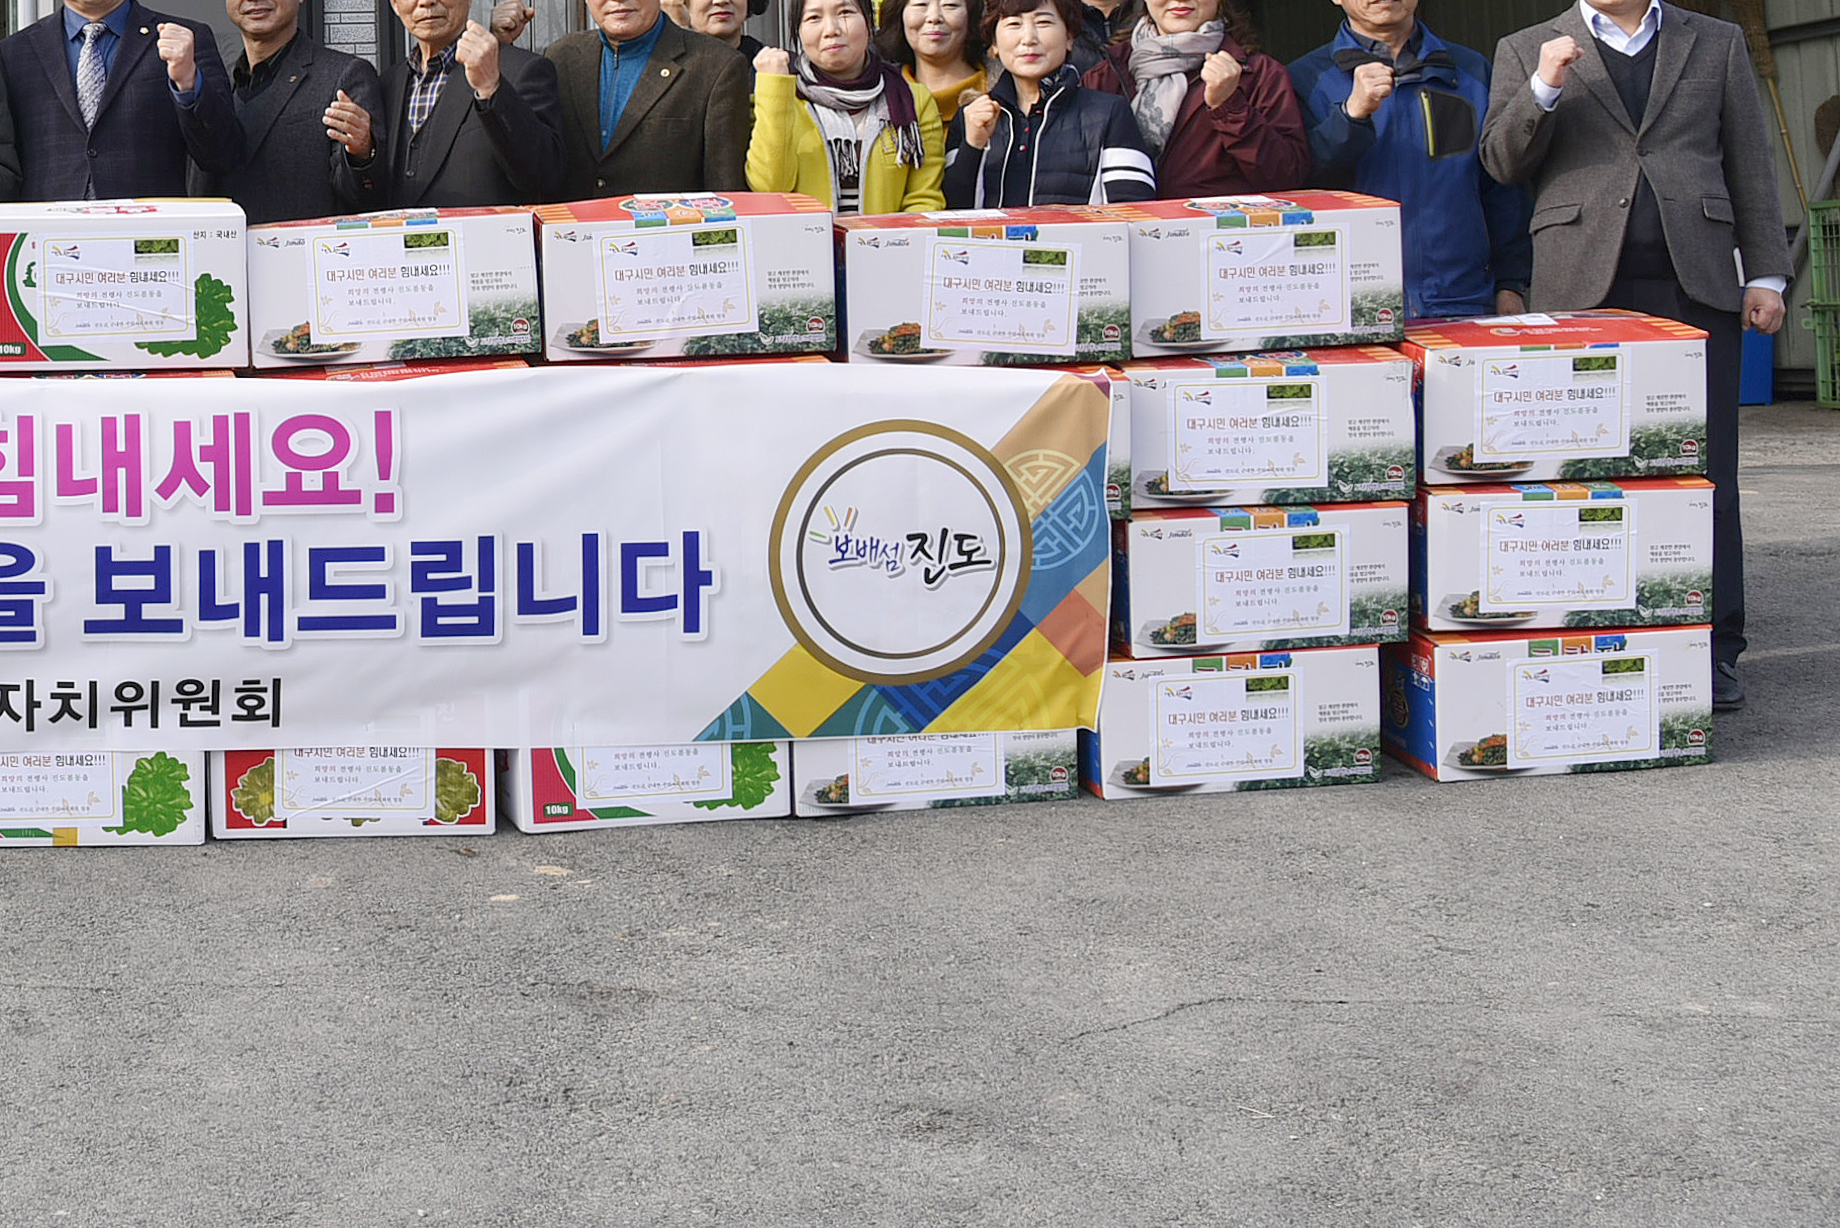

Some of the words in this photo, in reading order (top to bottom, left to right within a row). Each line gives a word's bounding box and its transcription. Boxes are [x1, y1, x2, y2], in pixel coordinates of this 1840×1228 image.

[216, 230, 237, 239] 국내산
[56, 272, 94, 284] 대구시민
[98, 272, 125, 283] 여러분
[129, 270, 179, 283] 힘내세요!!!
[326, 268, 365, 282] 대구시민
[368, 267, 397, 279] 여러분
[400, 263, 450, 278] 힘내세요!!!
[615, 267, 653, 282] 대구시민
[657, 265, 685, 278] 여러분
[689, 260, 739, 276] 힘내세요!!!
[1219, 266, 1255, 279] 대구시민
[1259, 265, 1285, 277] 여러분
[1289, 262, 1336, 276] 힘내세요!!!
[943, 276, 981, 290] 대구시민
[984, 279, 1012, 292] 여러분
[1015, 280, 1065, 295] 힘내세요!!!
[1494, 390, 1531, 403] 대구시민
[1535, 389, 1563, 401] 여러분
[1567, 386, 1616, 400] 힘내세요!!!
[1187, 418, 1225, 430] 대구시민
[1229, 417, 1257, 429] 여러분
[1262, 415, 1311, 428] 힘내세요!!!
[1500, 540, 1537, 552] 대구시민
[1541, 540, 1569, 551] 여러분
[1573, 538, 1622, 551] 힘내세요!!!
[828, 534, 901, 572] 보배섬
[906, 528, 992, 585] 진도
[1216, 570, 1252, 583] 대구시민
[1256, 568, 1283, 581] 여러분
[1287, 564, 1335, 579] 힘내세요!!!
[83, 531, 713, 642] 보내드립니다
[1526, 694, 1562, 708] 대구시민
[1566, 692, 1593, 705] 여러분
[1169, 712, 1205, 725] 대구시민
[1209, 710, 1236, 723] 여러분
[23, 755, 51, 767] 여러분
[545, 805, 569, 815] 10kg
